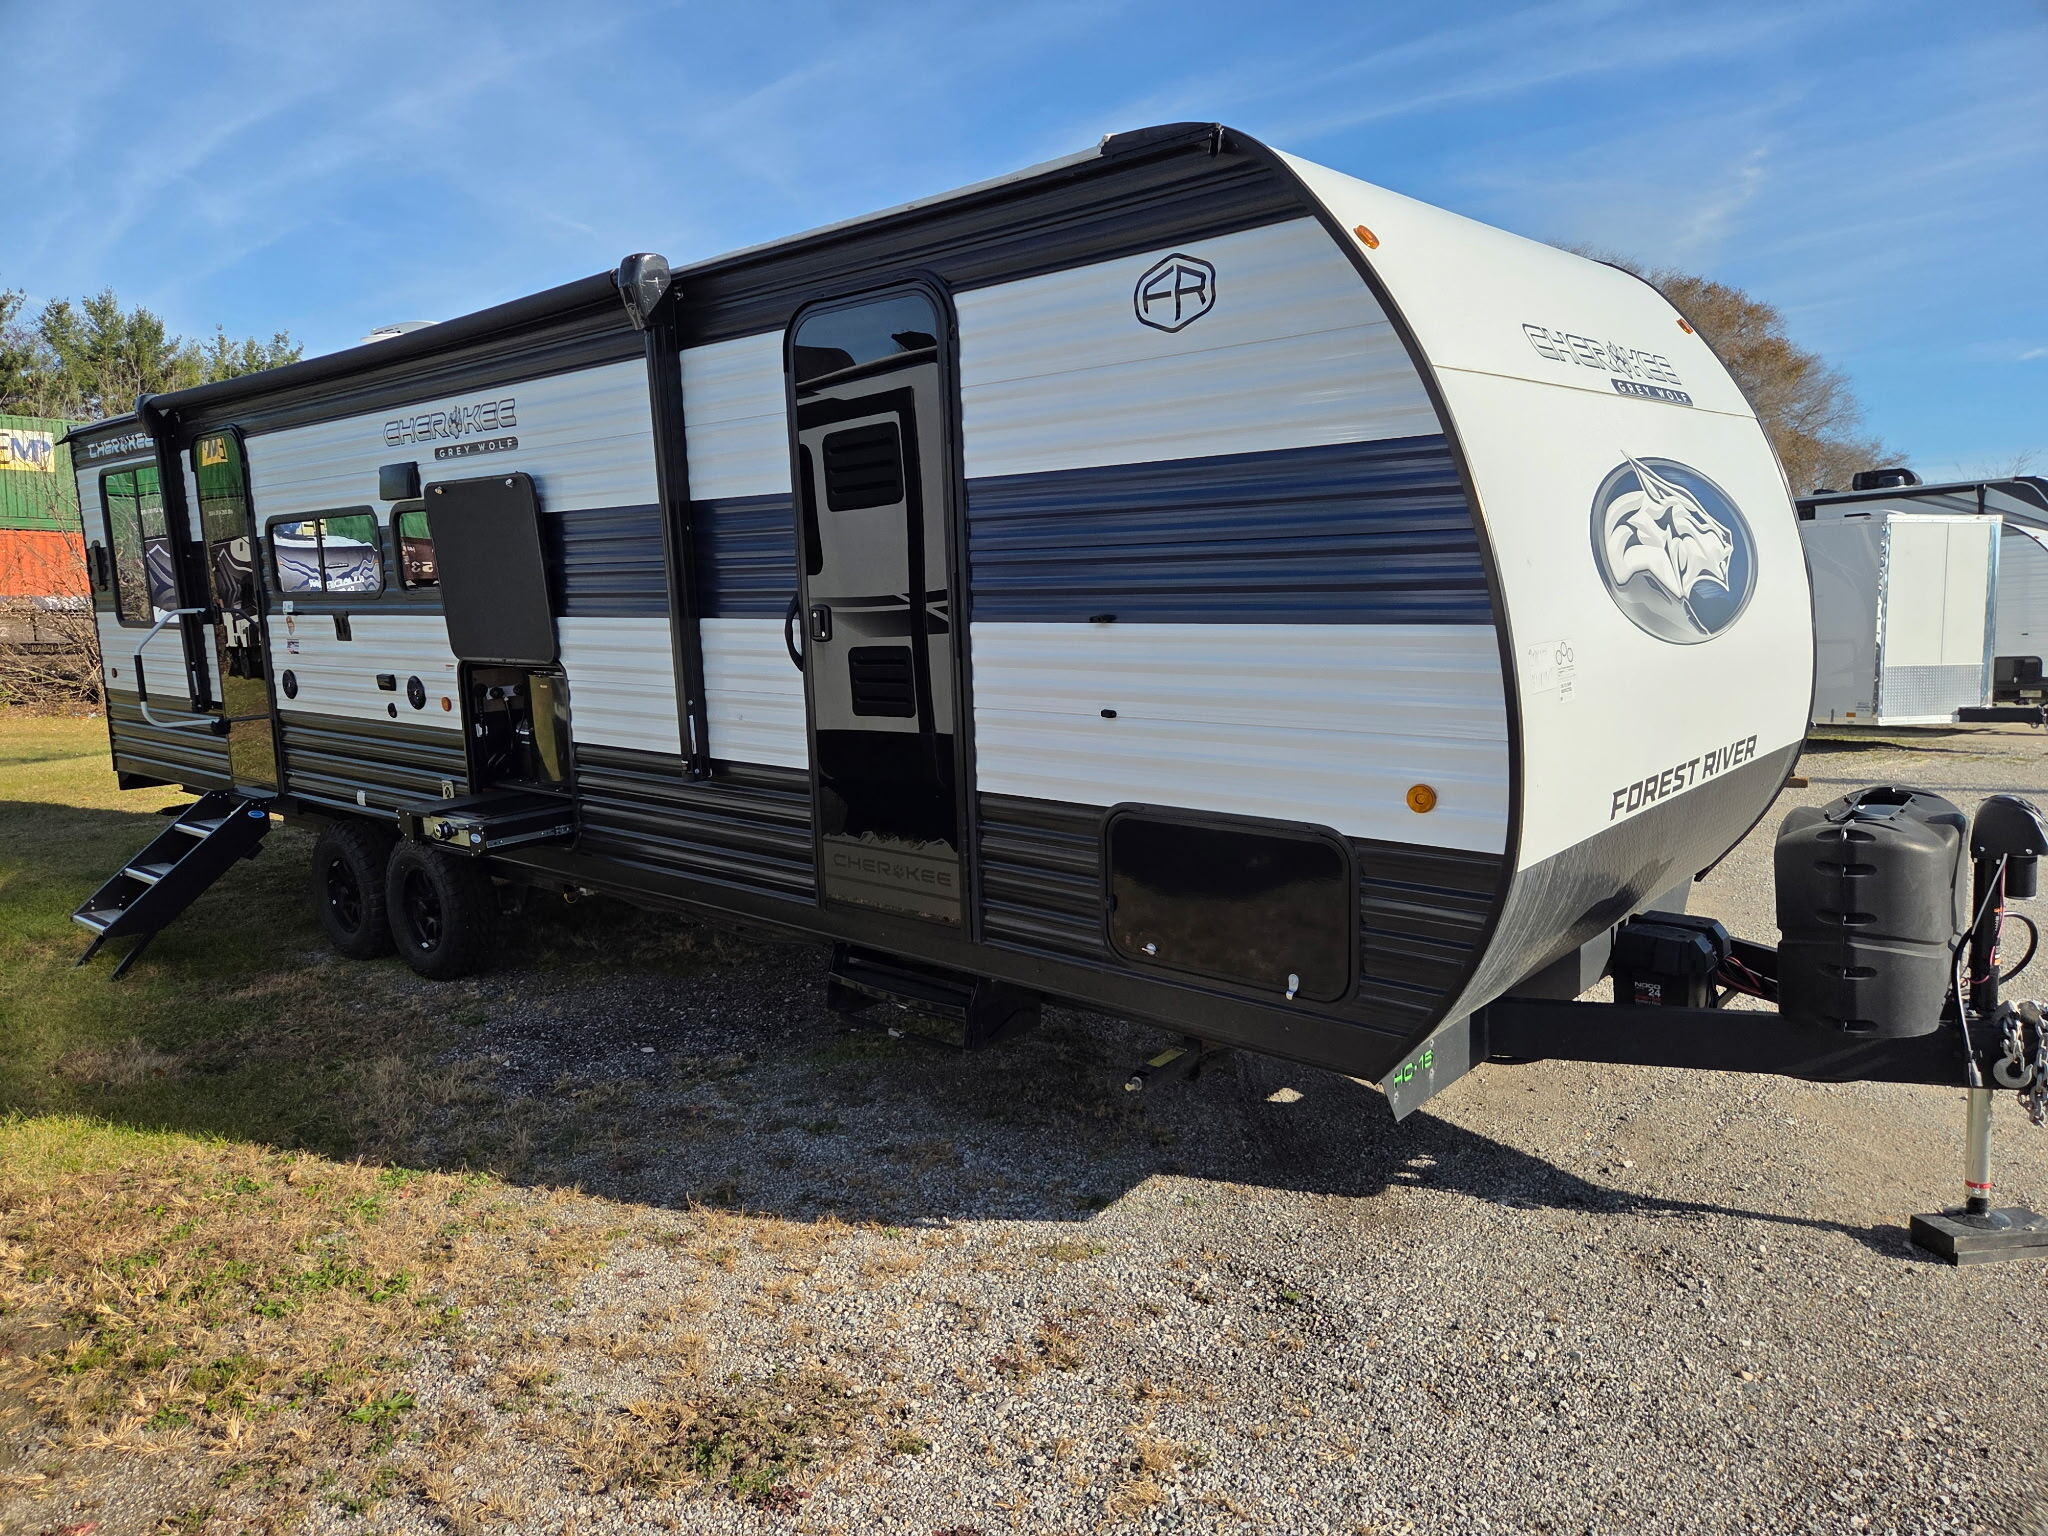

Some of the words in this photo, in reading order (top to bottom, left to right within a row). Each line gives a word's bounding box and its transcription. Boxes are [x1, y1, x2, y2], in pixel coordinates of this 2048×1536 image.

[1617, 381, 1651, 396] GREY
[1657, 387, 1688, 402] WOLF
[439, 444, 470, 458] GREY
[478, 438, 513, 451] WOLF
[1610, 756, 1702, 822] FOREST
[1702, 735, 1758, 780] RIVER
